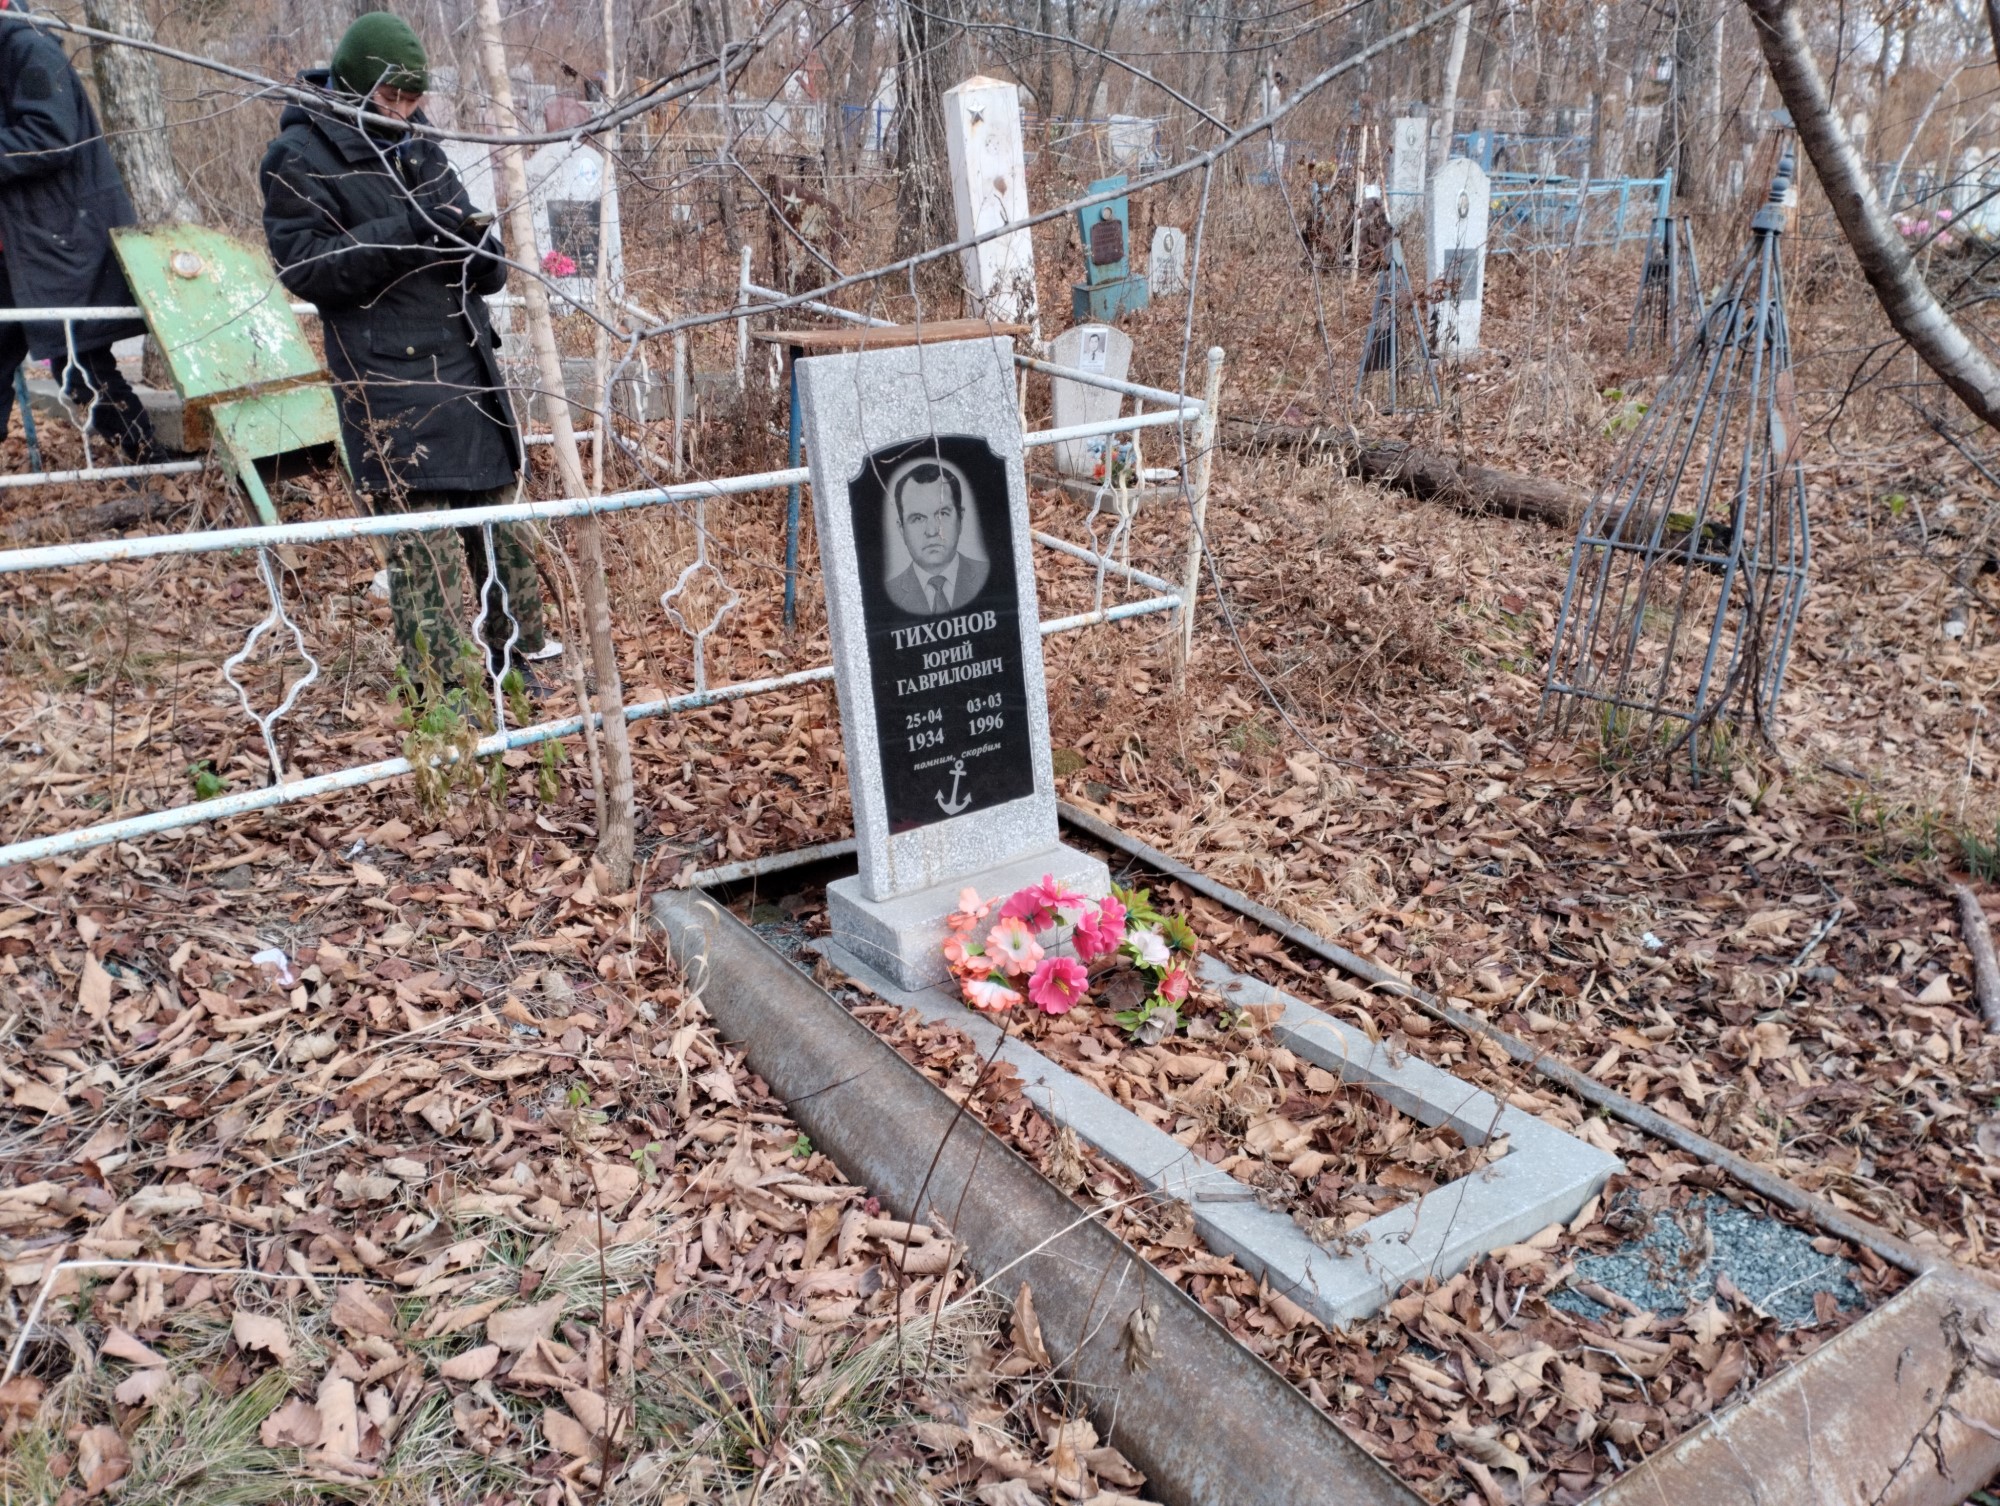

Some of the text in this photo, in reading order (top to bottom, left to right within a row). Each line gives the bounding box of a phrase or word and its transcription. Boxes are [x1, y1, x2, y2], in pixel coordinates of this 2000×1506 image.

[891, 610, 997, 650] ТИХОНОВ
[923, 640, 974, 670] ЮРИЙ
[897, 657, 1004, 696] ГАВРИЛОВИЧ
[969, 712, 1004, 736] 1996
[908, 728, 945, 752] 1934
[961, 742, 1002, 759] скорбим
